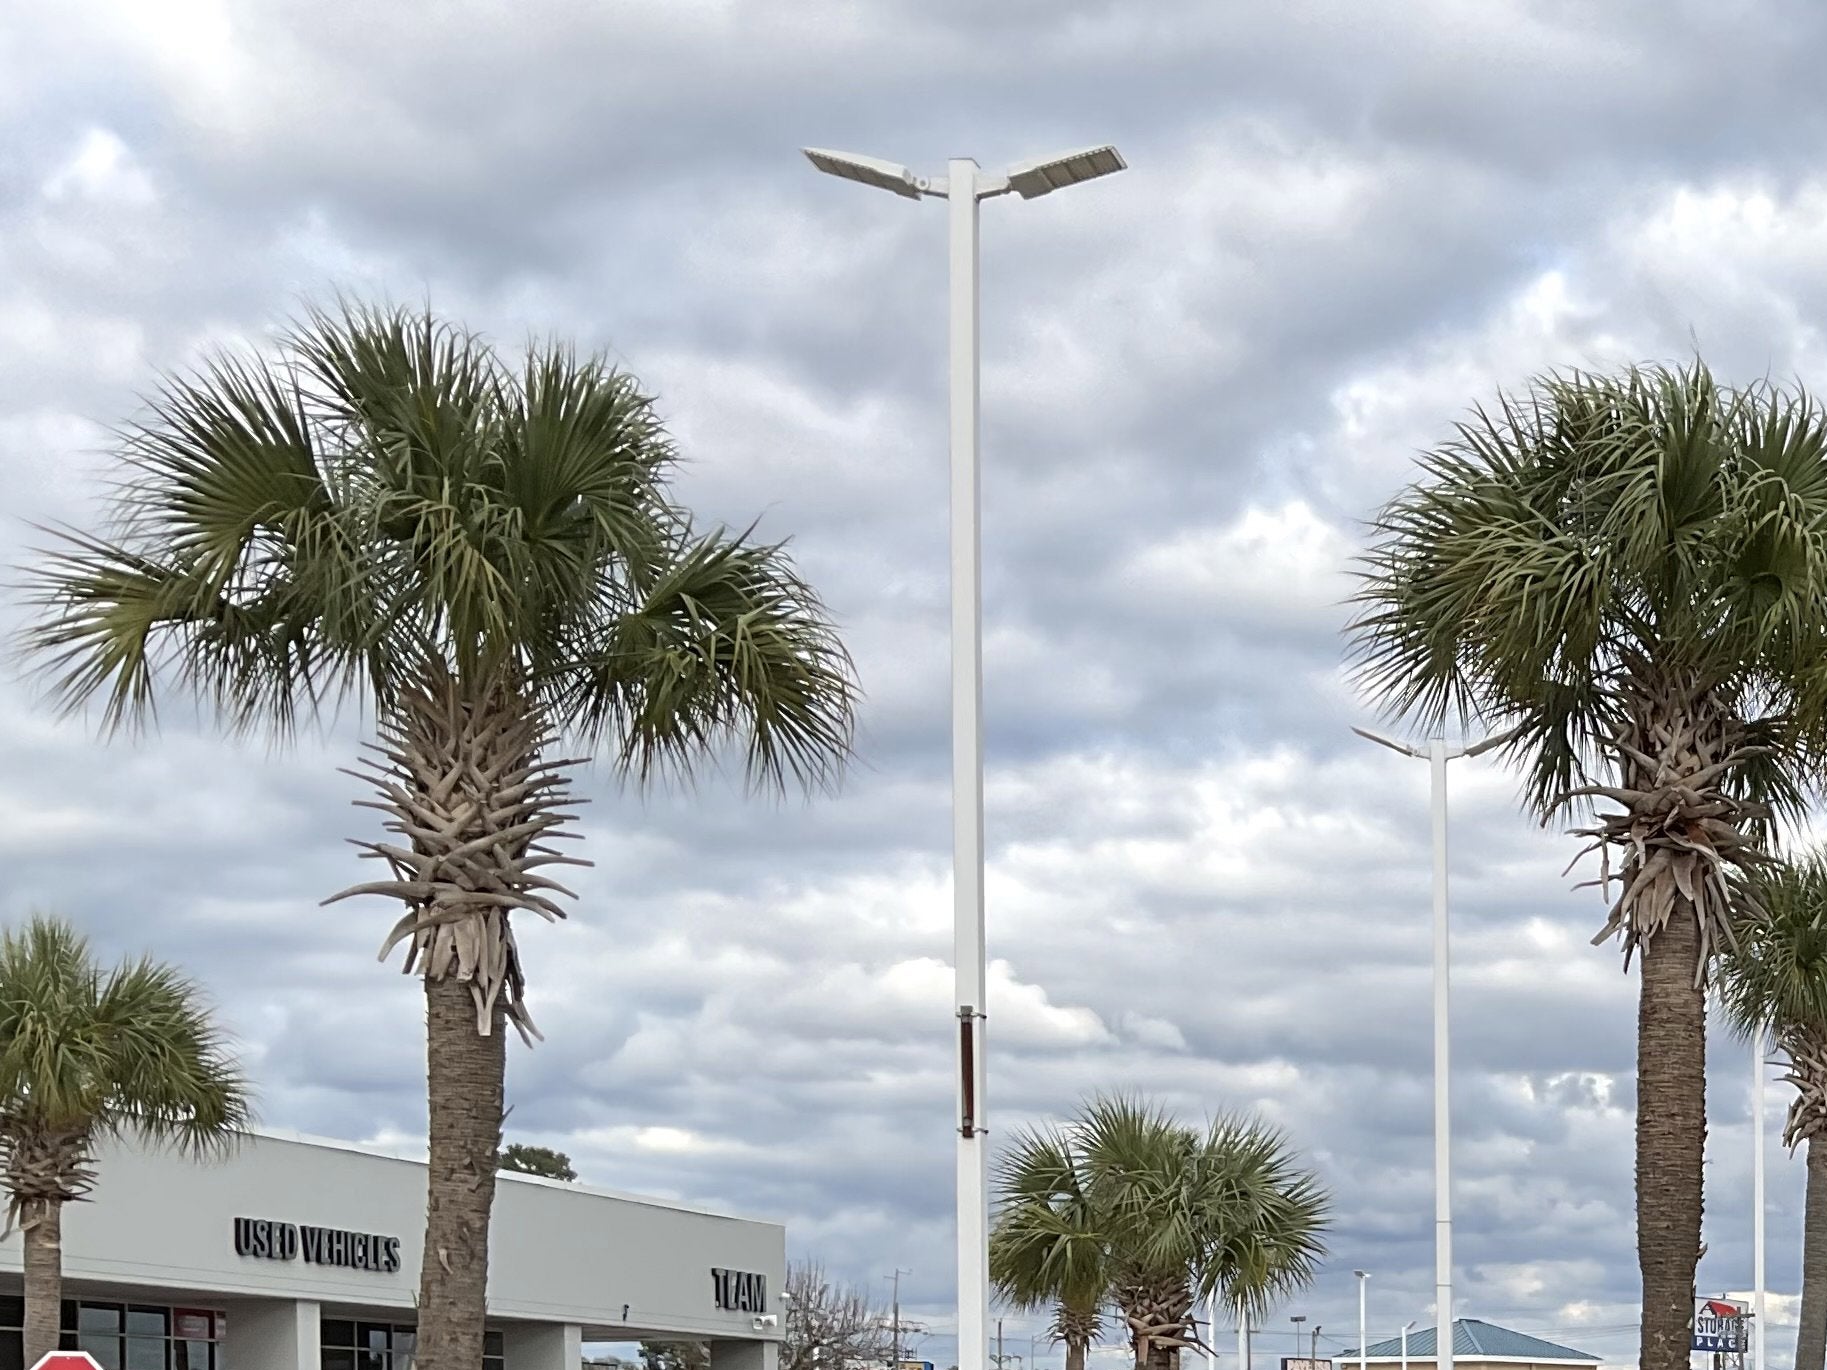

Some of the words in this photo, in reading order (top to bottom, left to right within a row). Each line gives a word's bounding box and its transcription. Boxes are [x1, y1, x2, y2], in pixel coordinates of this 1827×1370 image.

[234, 1217, 298, 1260] USED
[300, 1225, 400, 1272] VEHICLES
[711, 1268, 767, 1313] TEAM
